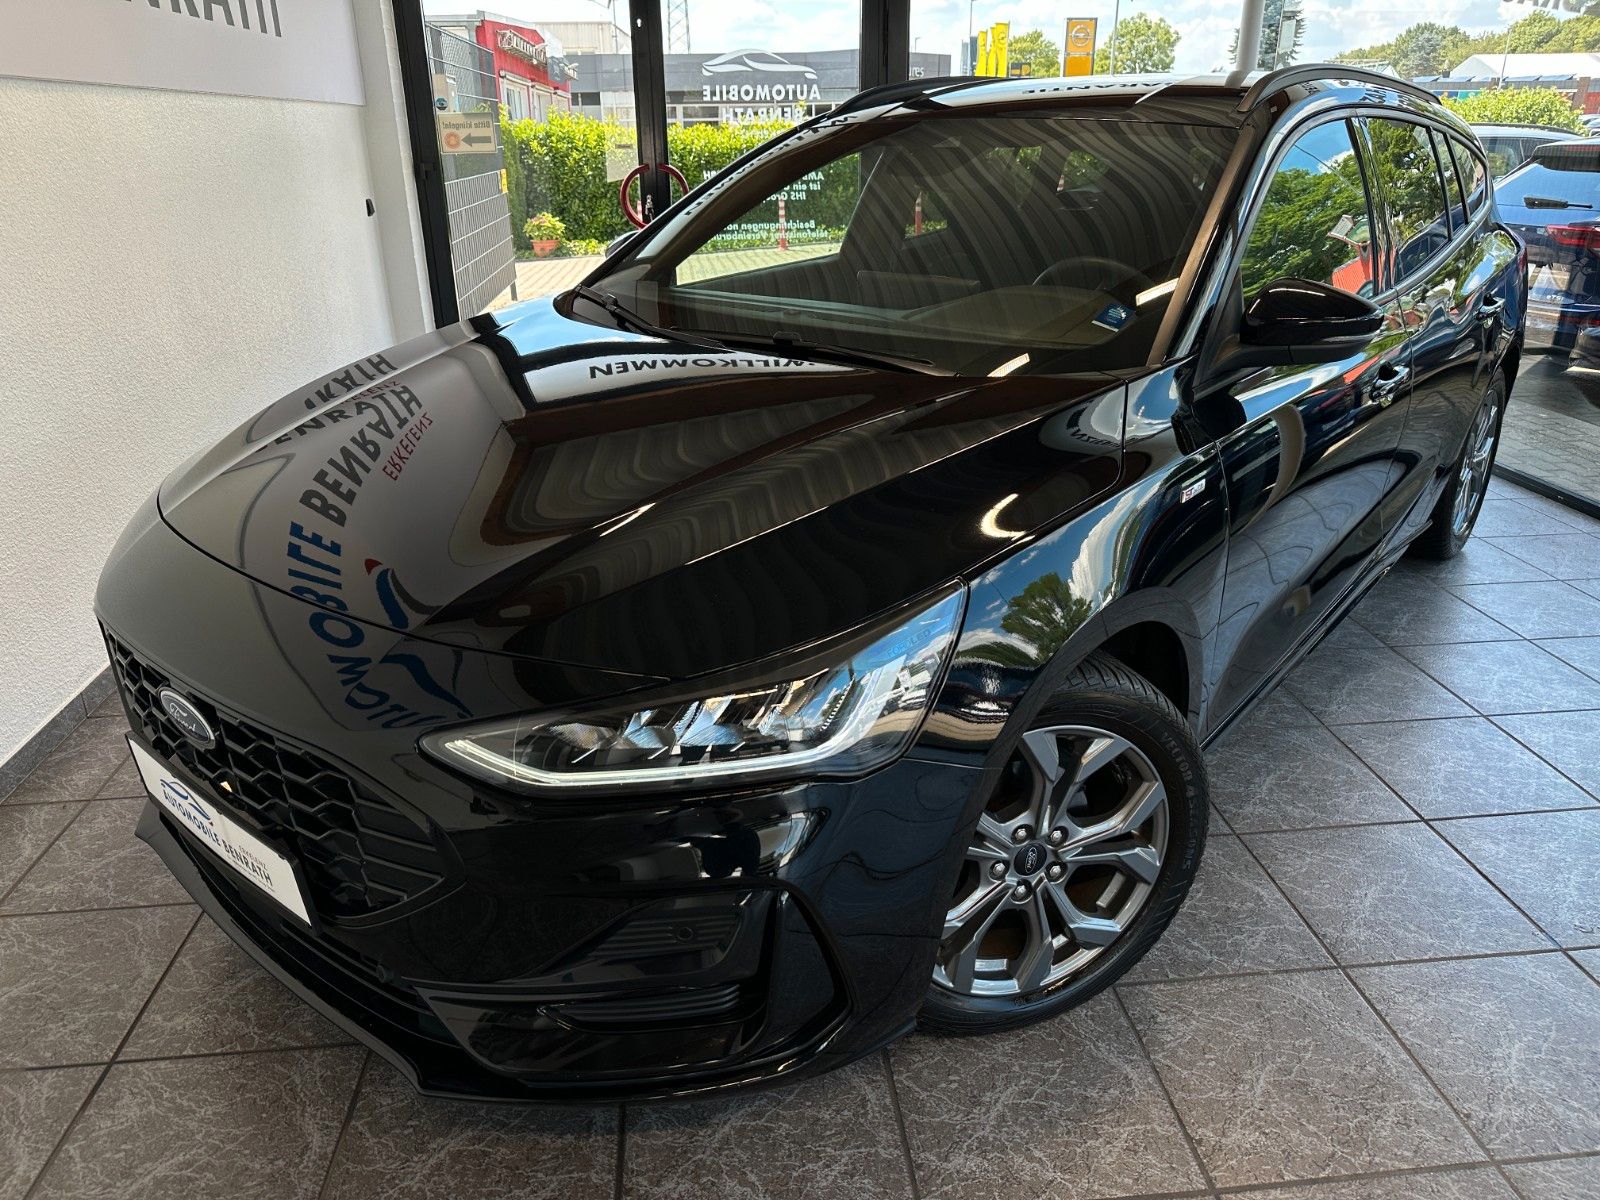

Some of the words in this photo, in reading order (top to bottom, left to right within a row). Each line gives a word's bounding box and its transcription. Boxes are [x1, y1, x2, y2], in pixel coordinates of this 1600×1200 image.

[169, 702, 196, 732] Ford
[162, 788, 222, 847] AUTOMOBILE
[221, 838, 274, 887] BENRATH
